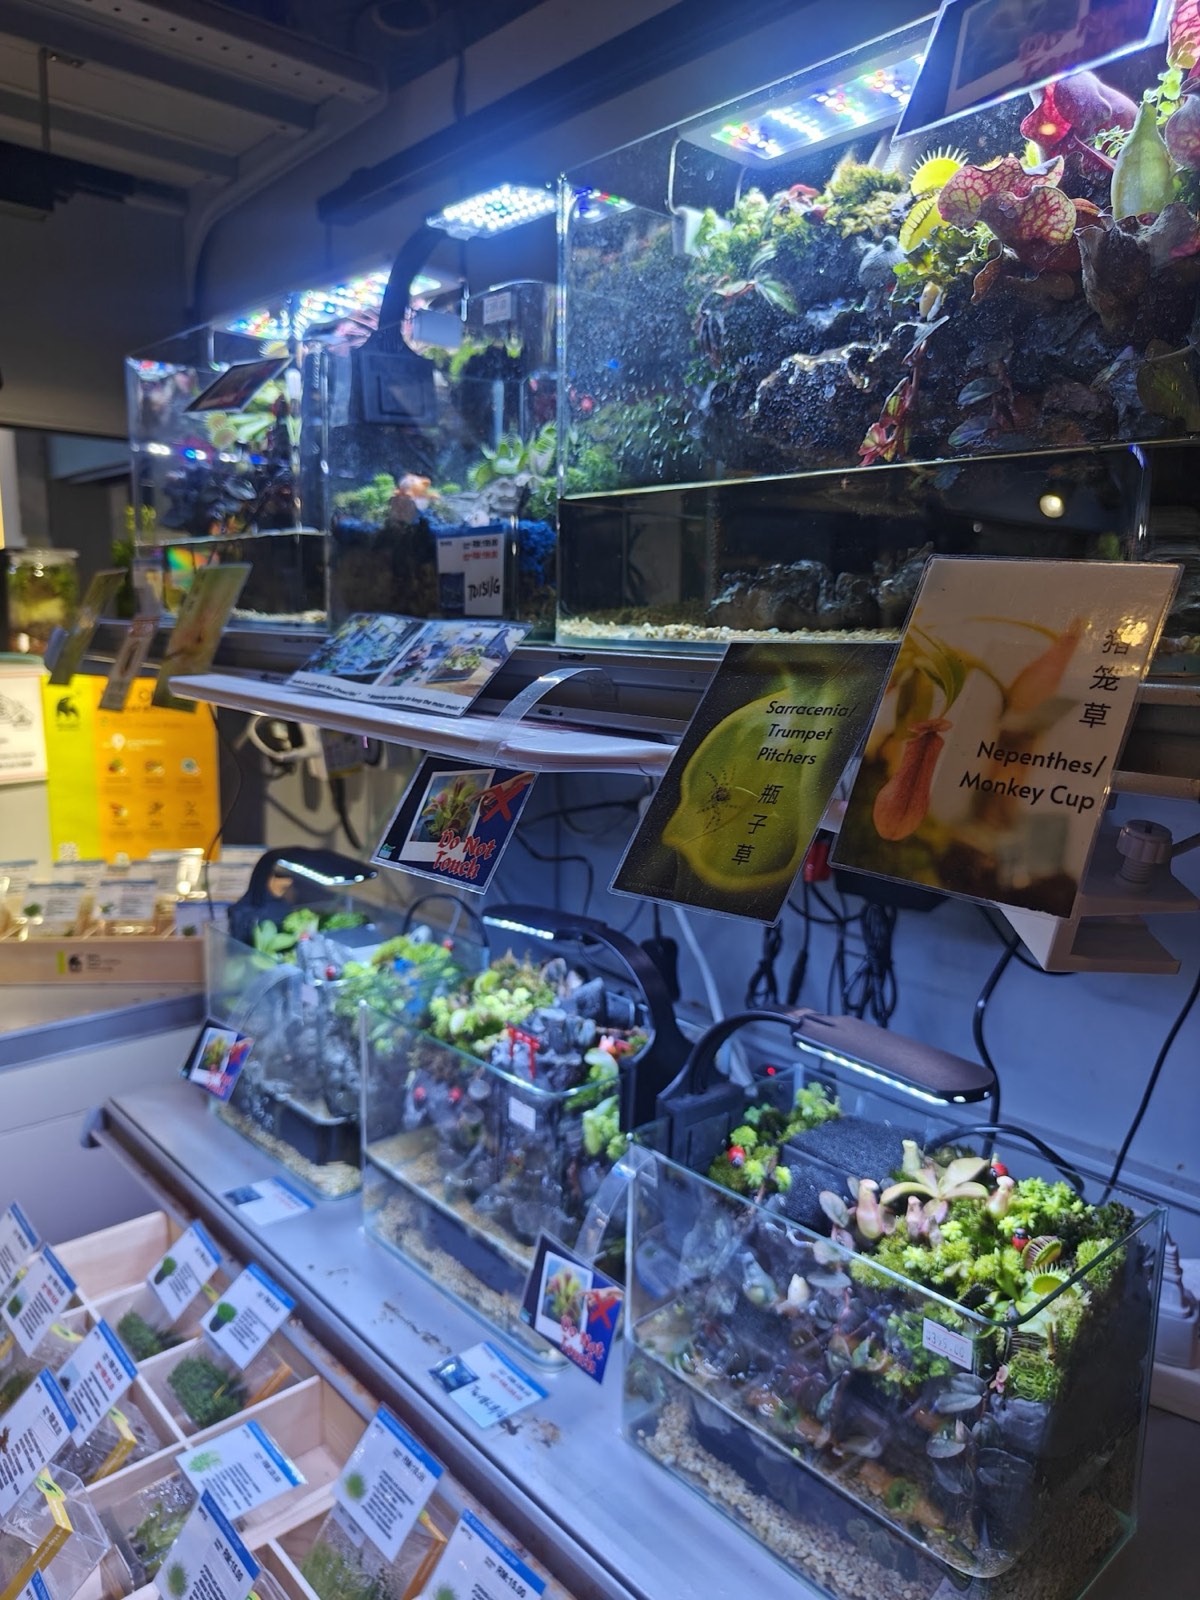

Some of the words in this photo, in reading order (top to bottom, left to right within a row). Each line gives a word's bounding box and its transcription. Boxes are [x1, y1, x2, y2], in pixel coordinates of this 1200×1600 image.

[766, 701, 859, 718] Sarracenia/
[768, 723, 833, 743] Trumpet
[756, 747, 817, 765] Pitchers
[977, 741, 1107, 777] Nepenthes/
[959, 771, 1044, 805] Monkey
[1050, 785, 1095, 814] Cup
[731, 784, 784, 866] 瓶子草
[438, 829, 461, 850] Do
[462, 835, 497, 861] Not
[433, 850, 481, 880] Touch
